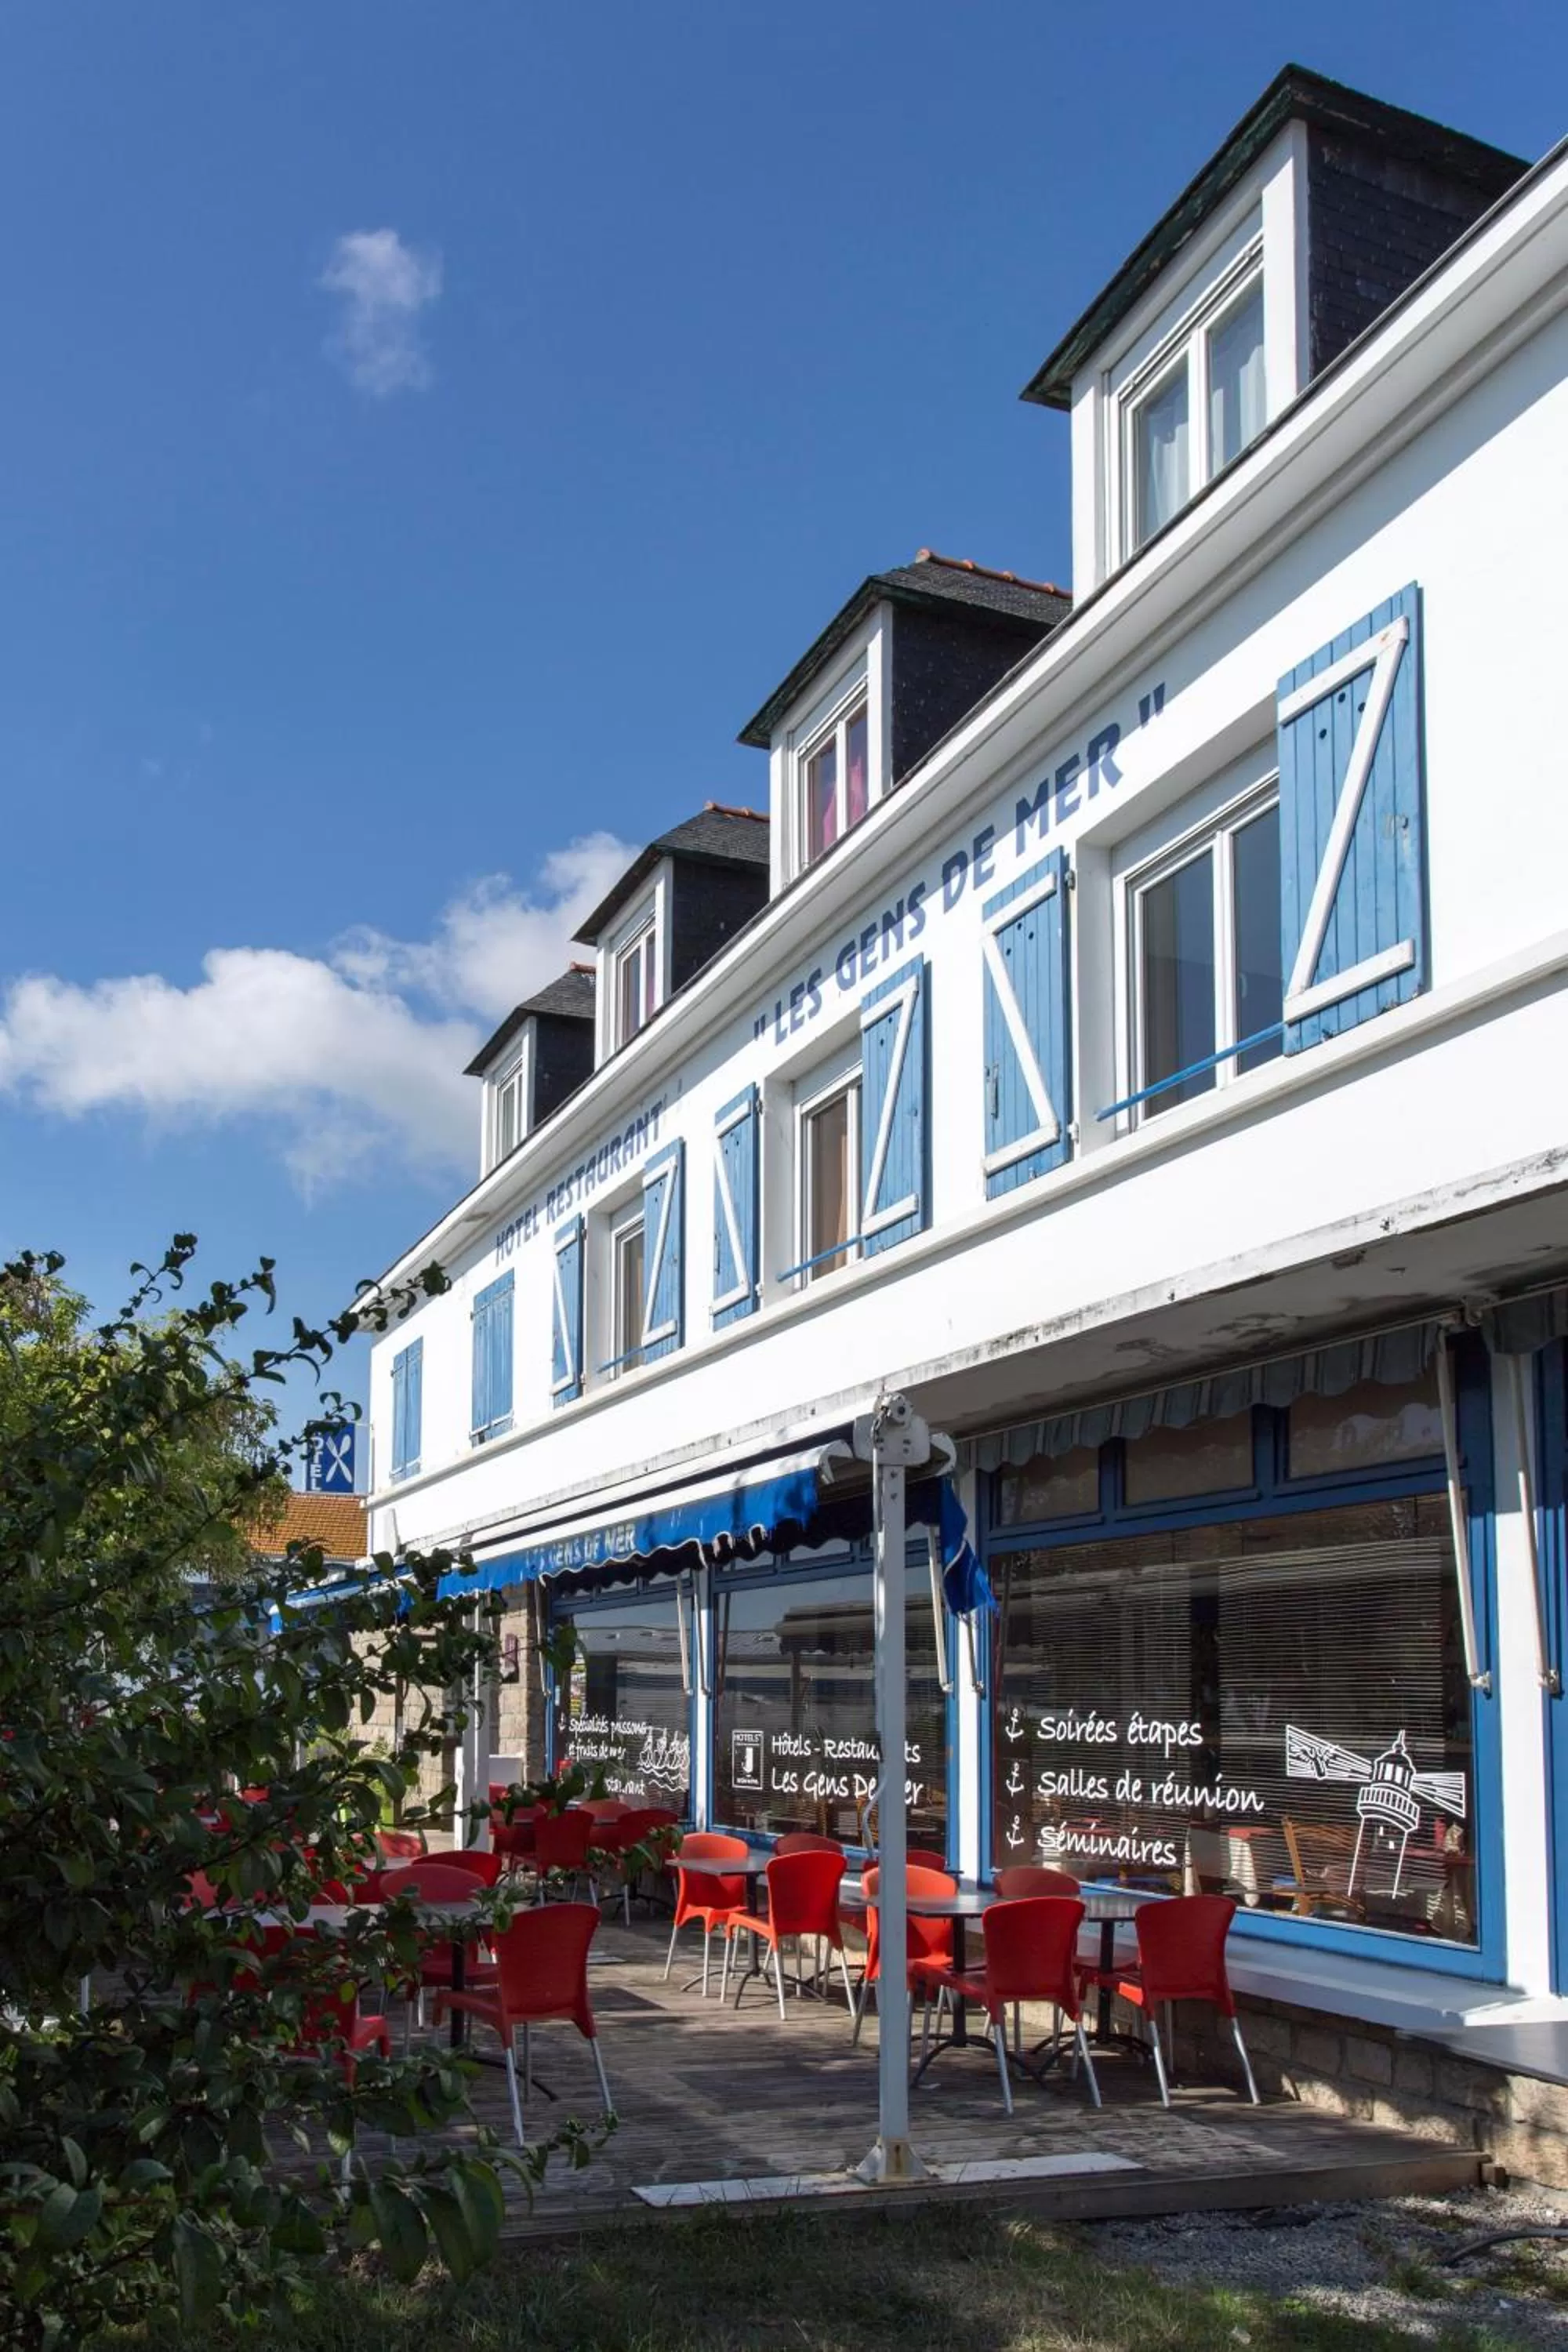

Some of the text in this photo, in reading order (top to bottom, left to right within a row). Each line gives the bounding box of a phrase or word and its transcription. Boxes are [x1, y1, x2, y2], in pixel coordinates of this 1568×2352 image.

[835, 881, 927, 991] GENS
[942, 824, 995, 914] DE
[495, 1101, 663, 1267] HOTEL RESTAURANT
[309, 1428, 324, 1490] OTEL
[598, 1740, 608, 1759] de
[771, 1732, 811, 1757] Hôtels
[1037, 1708, 1203, 1759] Soirées étapes
[771, 1767, 924, 1804] Les Gens De er
[1037, 1769, 1265, 1812] Salles de réunion
[1037, 1821, 1178, 1865] Séminaires
